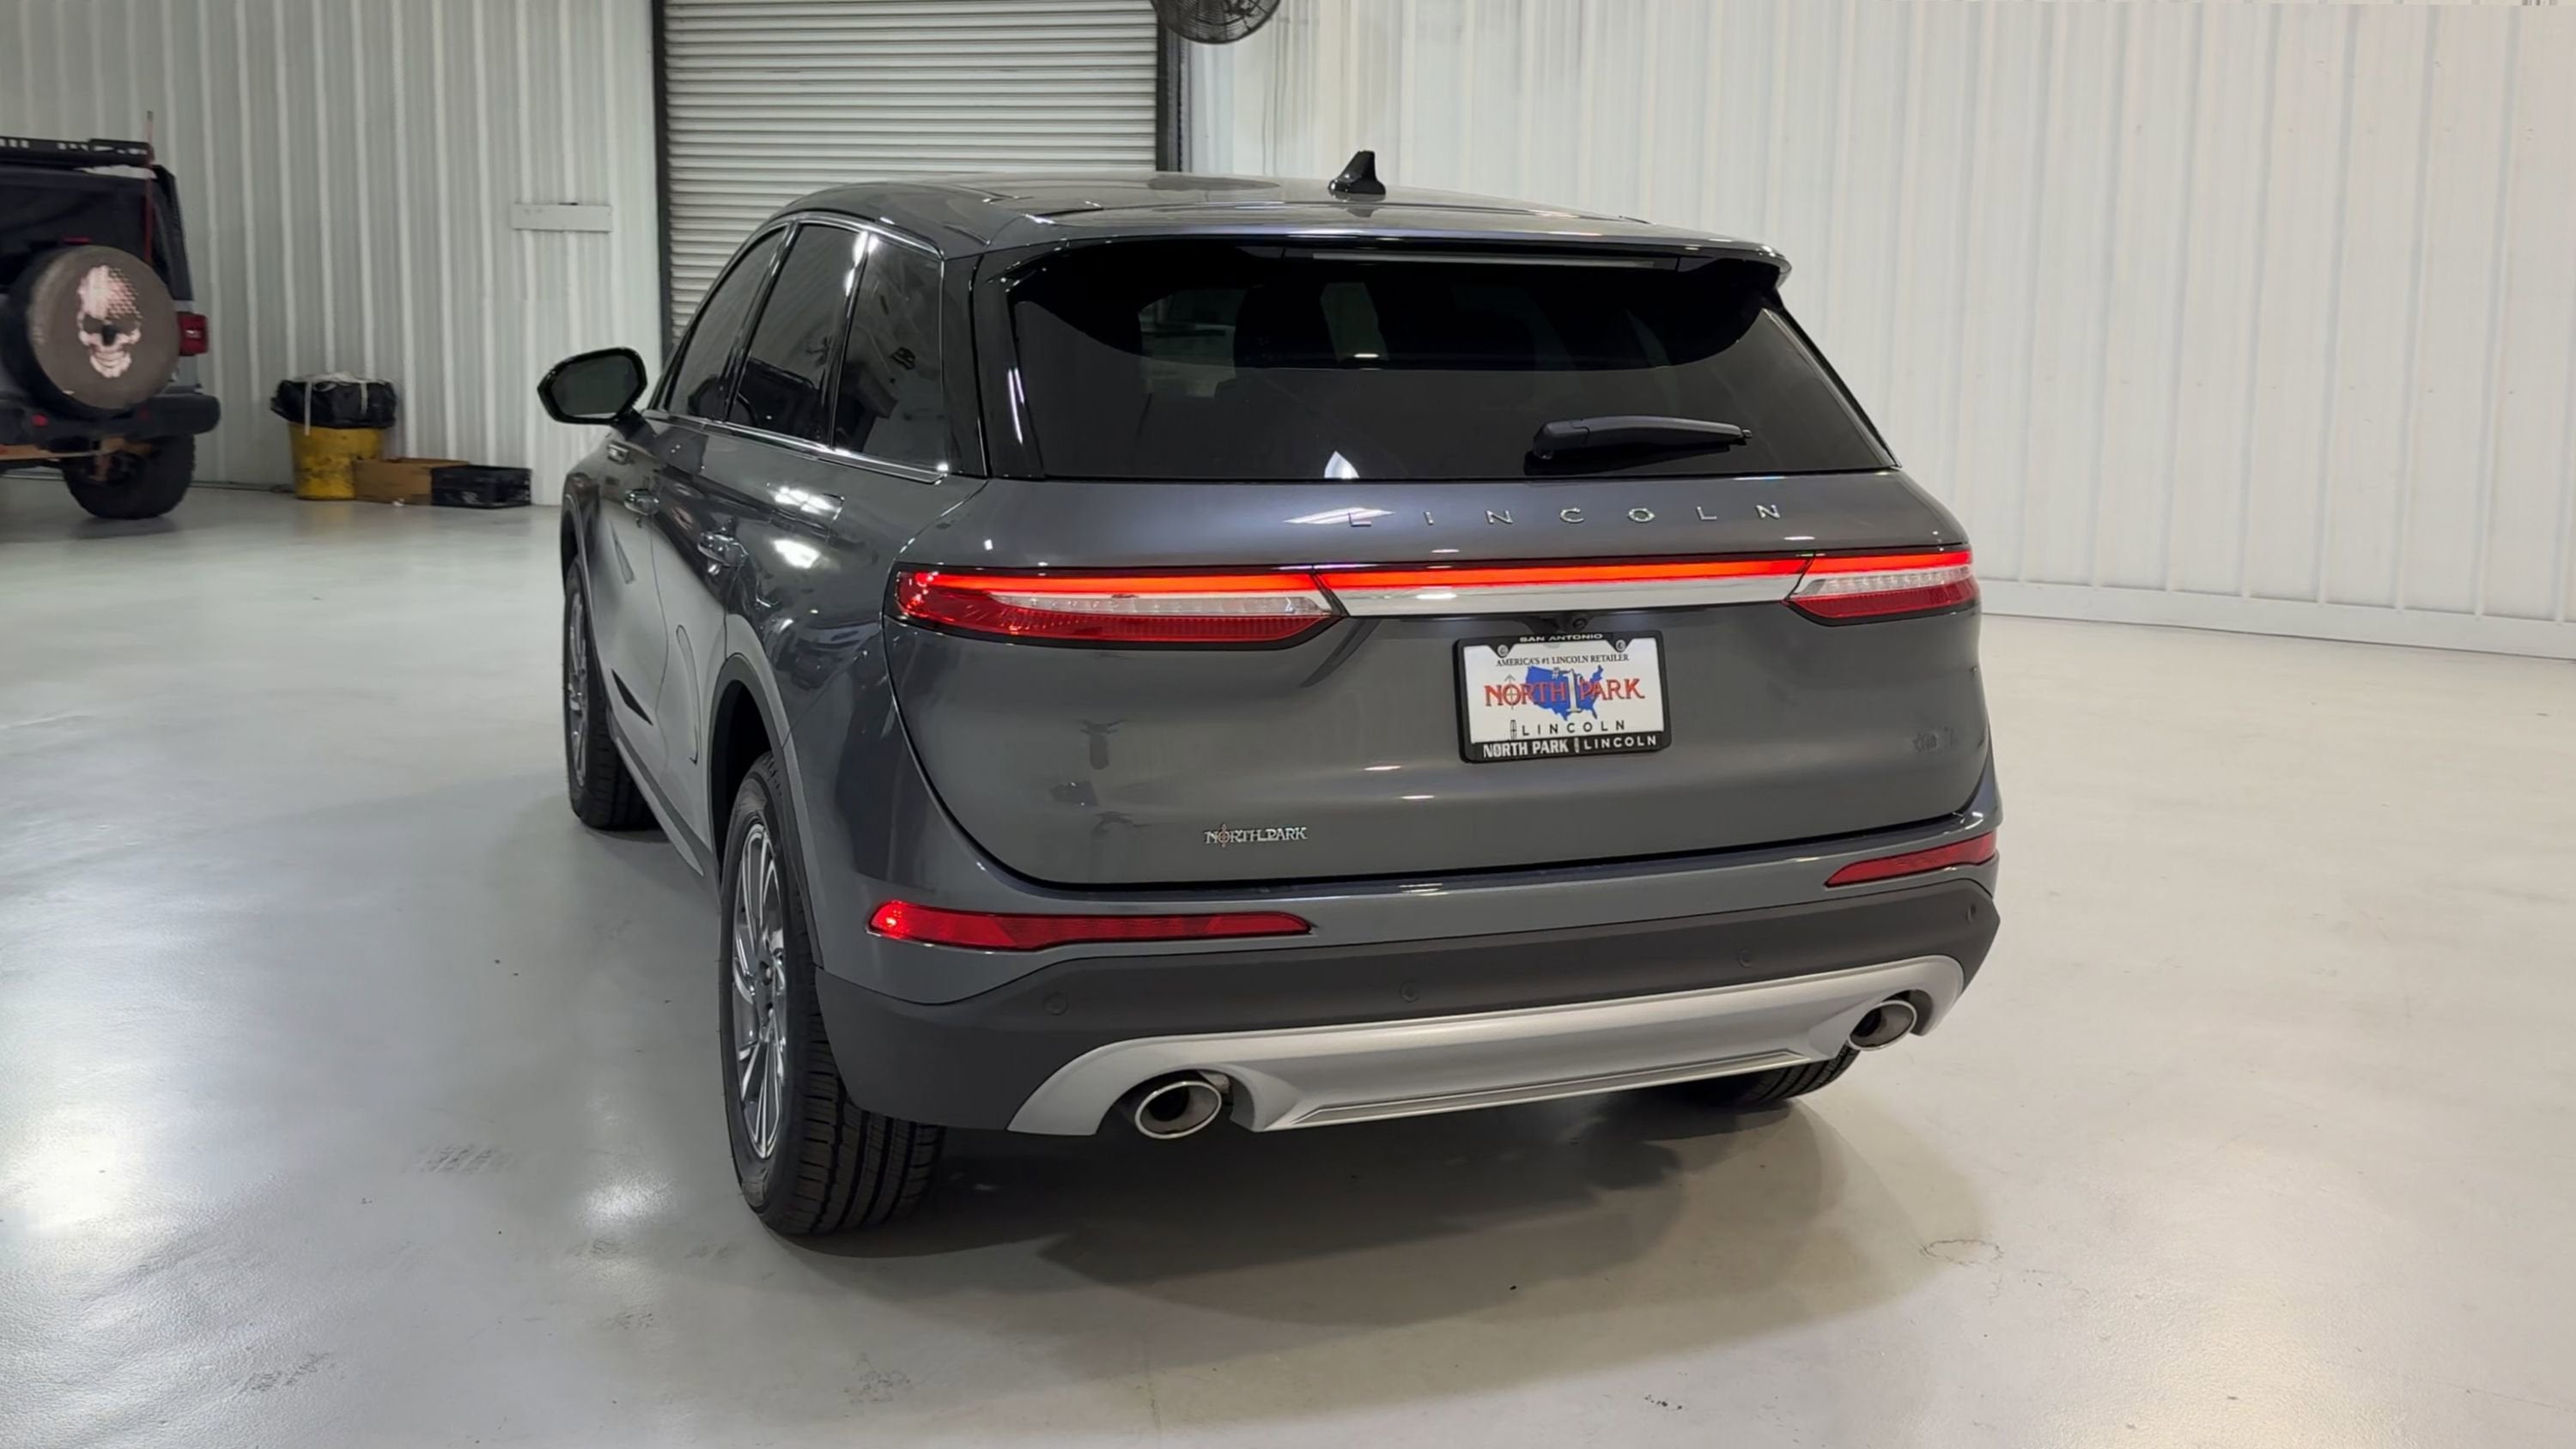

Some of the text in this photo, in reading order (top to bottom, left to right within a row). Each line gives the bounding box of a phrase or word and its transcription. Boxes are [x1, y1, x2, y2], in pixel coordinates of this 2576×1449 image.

[1348, 502, 1782, 528] LINCOLN
[1496, 658, 1540, 667] AMERICA'S
[1552, 655, 1589, 664] LINCOLN
[1590, 653, 1630, 663] RETAILER
[1484, 678, 1645, 706] NORTH PARK
[1522, 720, 1625, 737] LINCOLN
[1483, 735, 1657, 758] NORTH PARK LINCOLN
